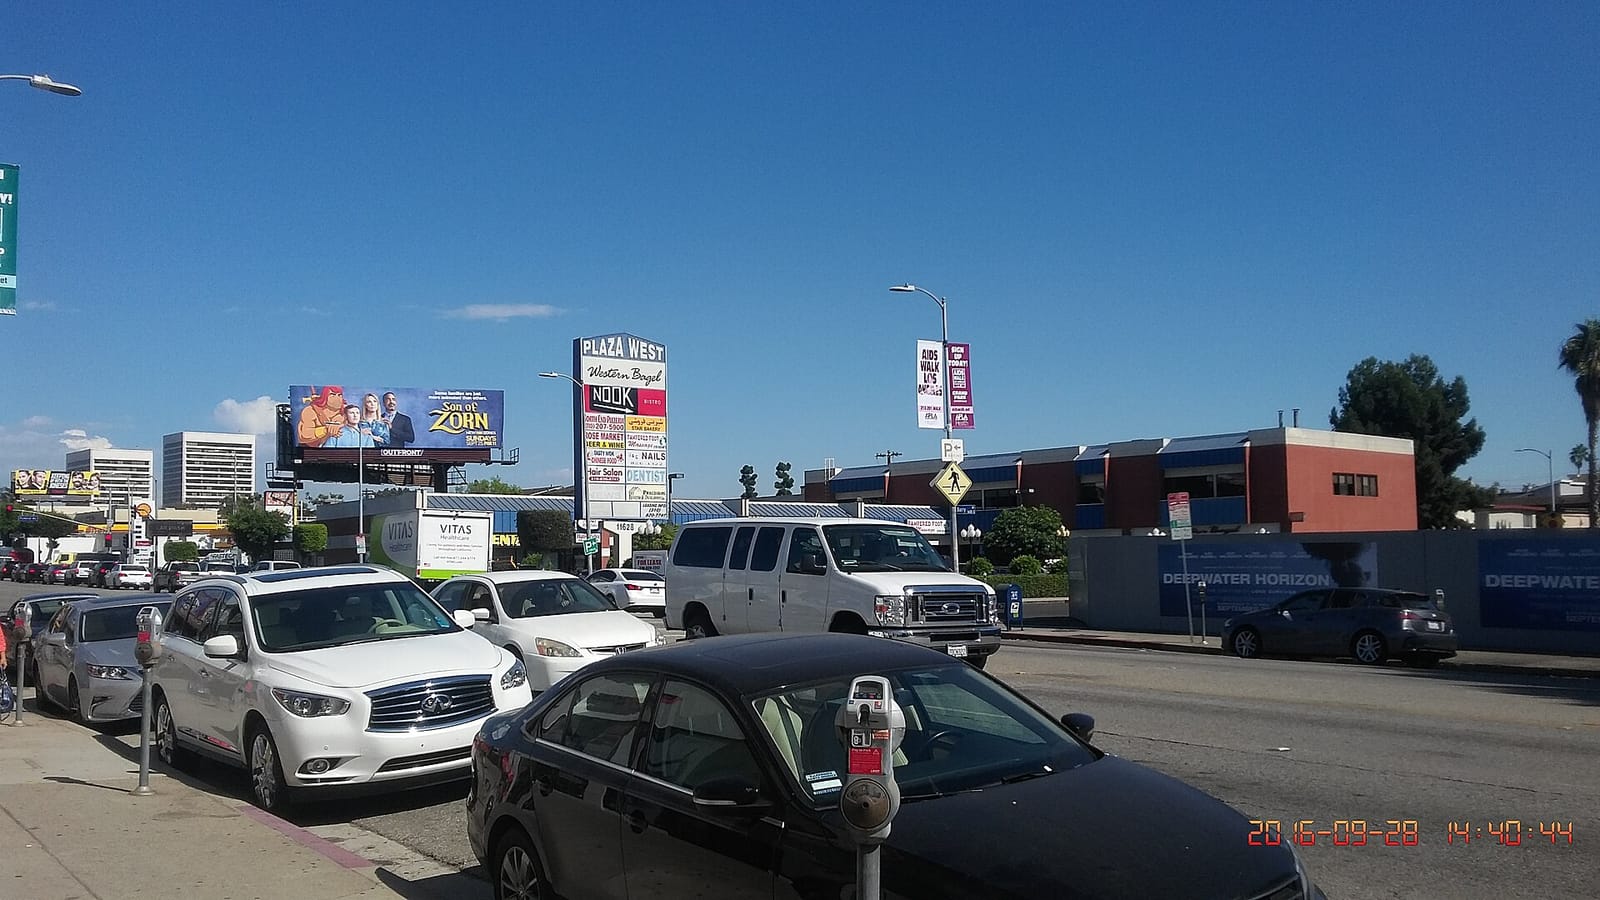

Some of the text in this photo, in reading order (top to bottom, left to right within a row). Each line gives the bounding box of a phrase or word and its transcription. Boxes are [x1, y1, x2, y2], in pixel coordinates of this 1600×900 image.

[583, 336, 664, 361] PLAZA WEST
[921, 349, 938, 361] AIDS
[920, 360, 940, 373] WALK
[587, 365, 662, 387] Western Bagel
[923, 373, 937, 384] LOS
[593, 386, 634, 408] NOOK
[442, 402, 478, 412] Son of
[429, 409, 489, 434] ZORN
[600, 432, 624, 441] MARKET
[641, 452, 666, 460] NAILS
[944, 443, 953, 457] P
[603, 468, 623, 476] Salon
[627, 469, 665, 482] DENTIST
[388, 520, 413, 540] VITAS
[440, 524, 472, 534] VITAS
[1163, 573, 1331, 586] DEEPWATER HORIZON
